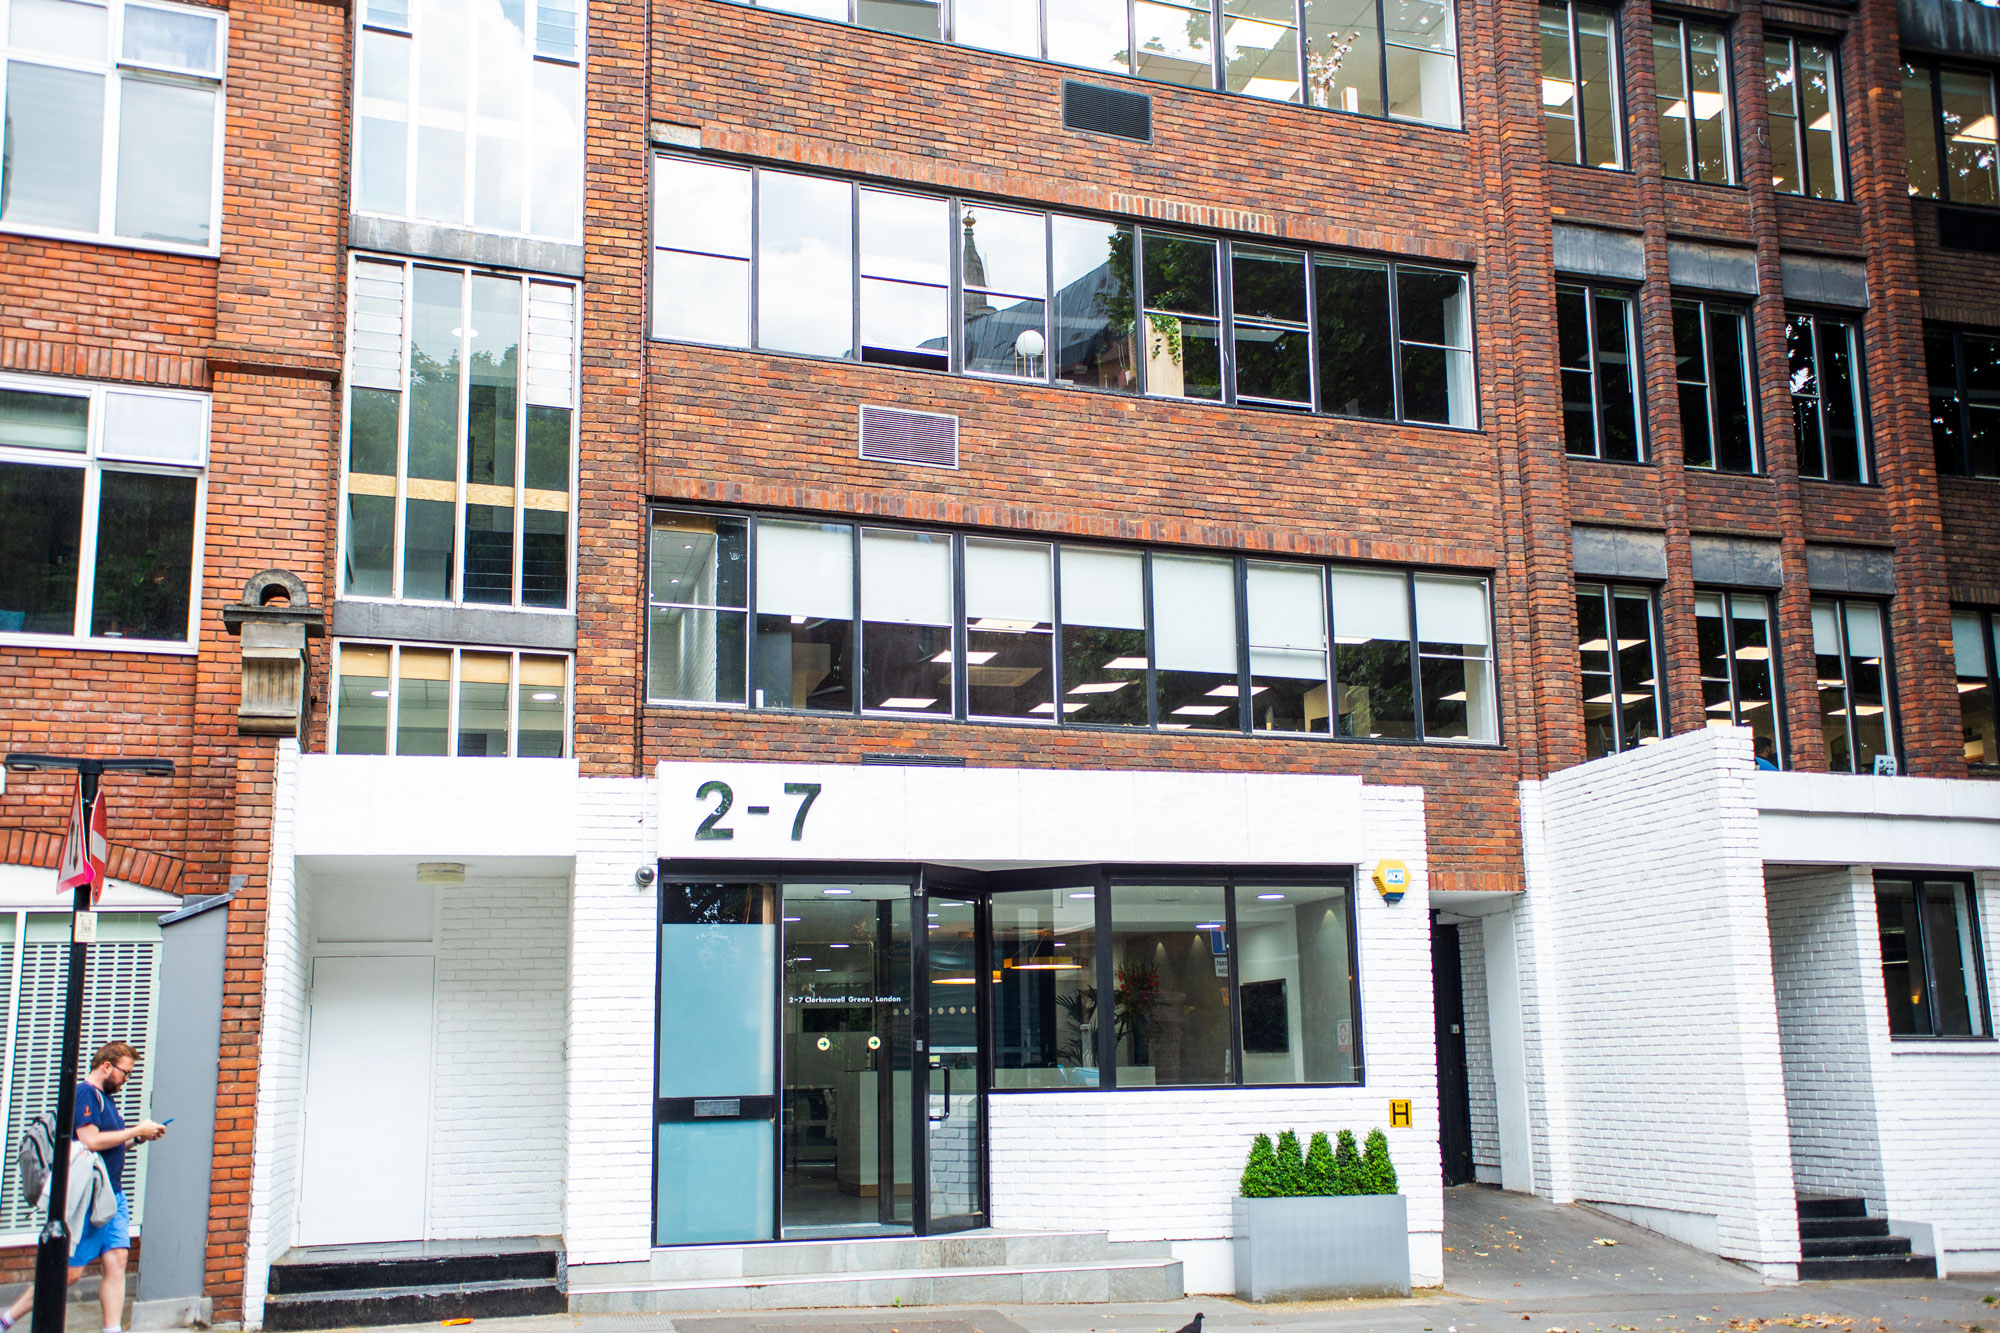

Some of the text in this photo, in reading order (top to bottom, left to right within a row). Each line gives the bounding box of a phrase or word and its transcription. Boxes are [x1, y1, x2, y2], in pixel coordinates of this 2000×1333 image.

[694, 780, 822, 841] 2-7
[1387, 871, 1404, 882] ADT
[805, 995, 846, 1003] Clerkenwell
[848, 995, 873, 1003] Green,
[875, 995, 901, 1003] London
[1392, 1102, 1409, 1125] H
